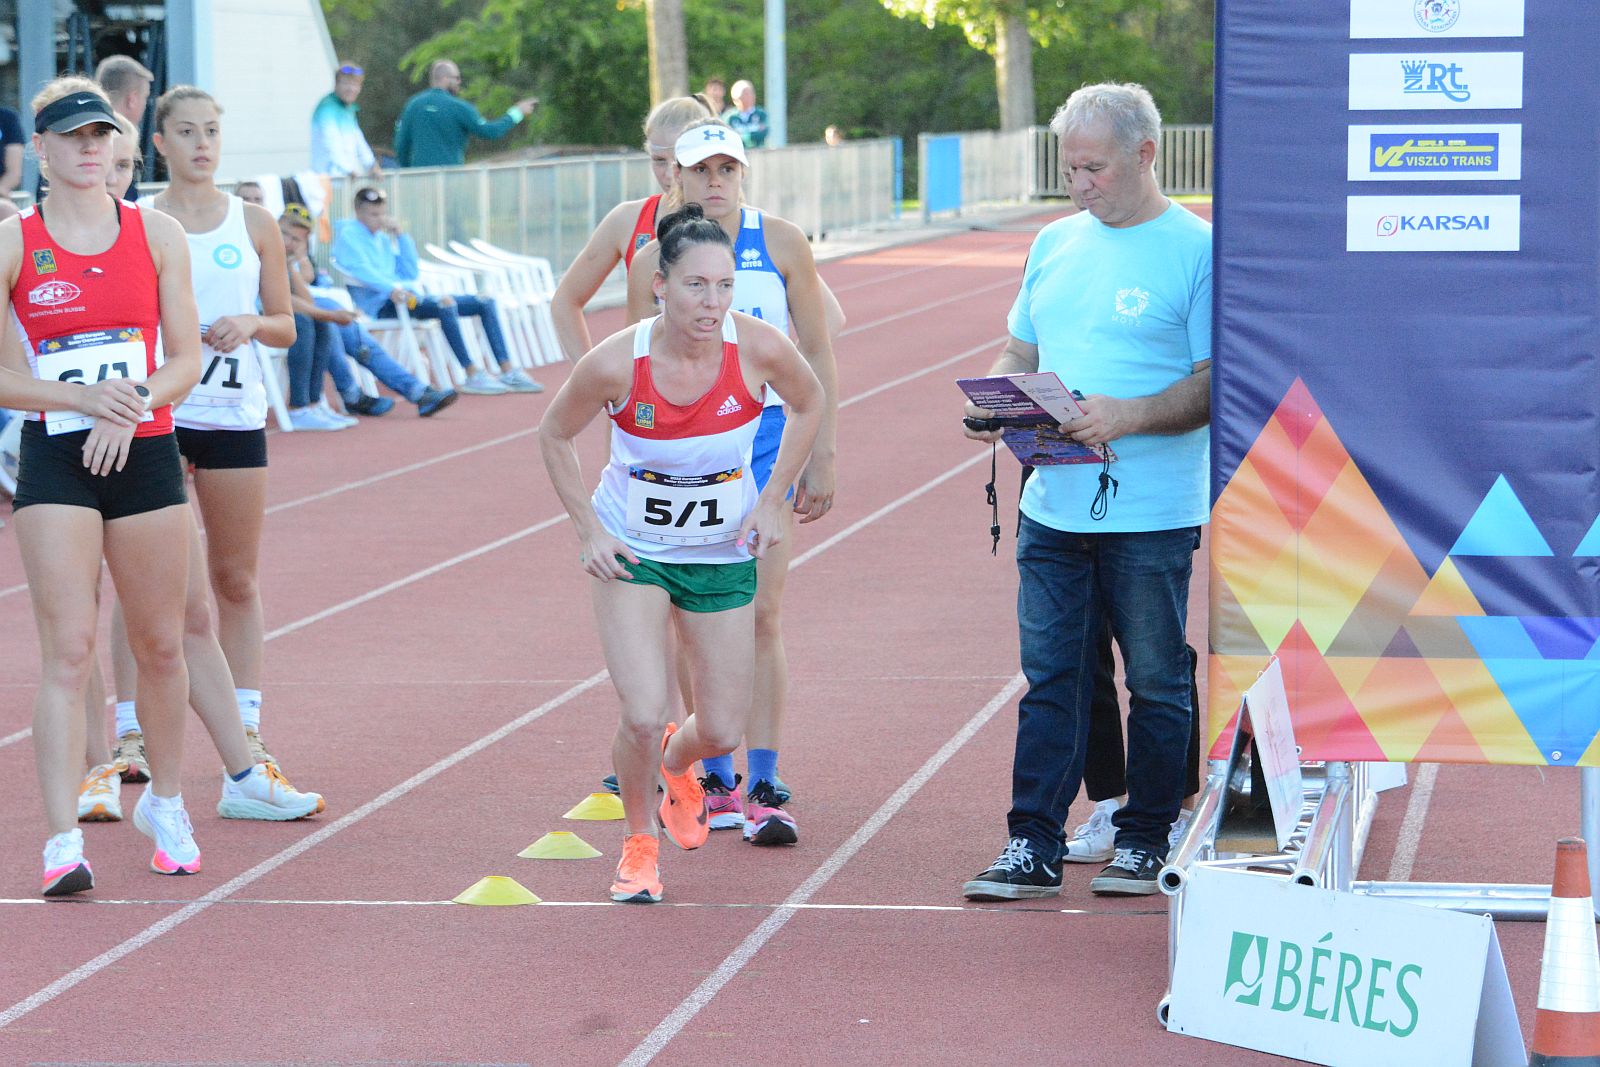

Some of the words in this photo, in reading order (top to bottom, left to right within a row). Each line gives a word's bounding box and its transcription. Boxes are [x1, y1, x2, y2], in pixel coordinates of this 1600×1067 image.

[1405, 153, 1449, 167] VISZLÓ
[1451, 155, 1493, 166] TRANS
[1400, 215, 1490, 231] KARSAI
[741, 260, 763, 269] errea
[717, 404, 742, 416] adidas
[644, 497, 725, 528] 5/1
[1270, 931, 1424, 1039] BÉRES
